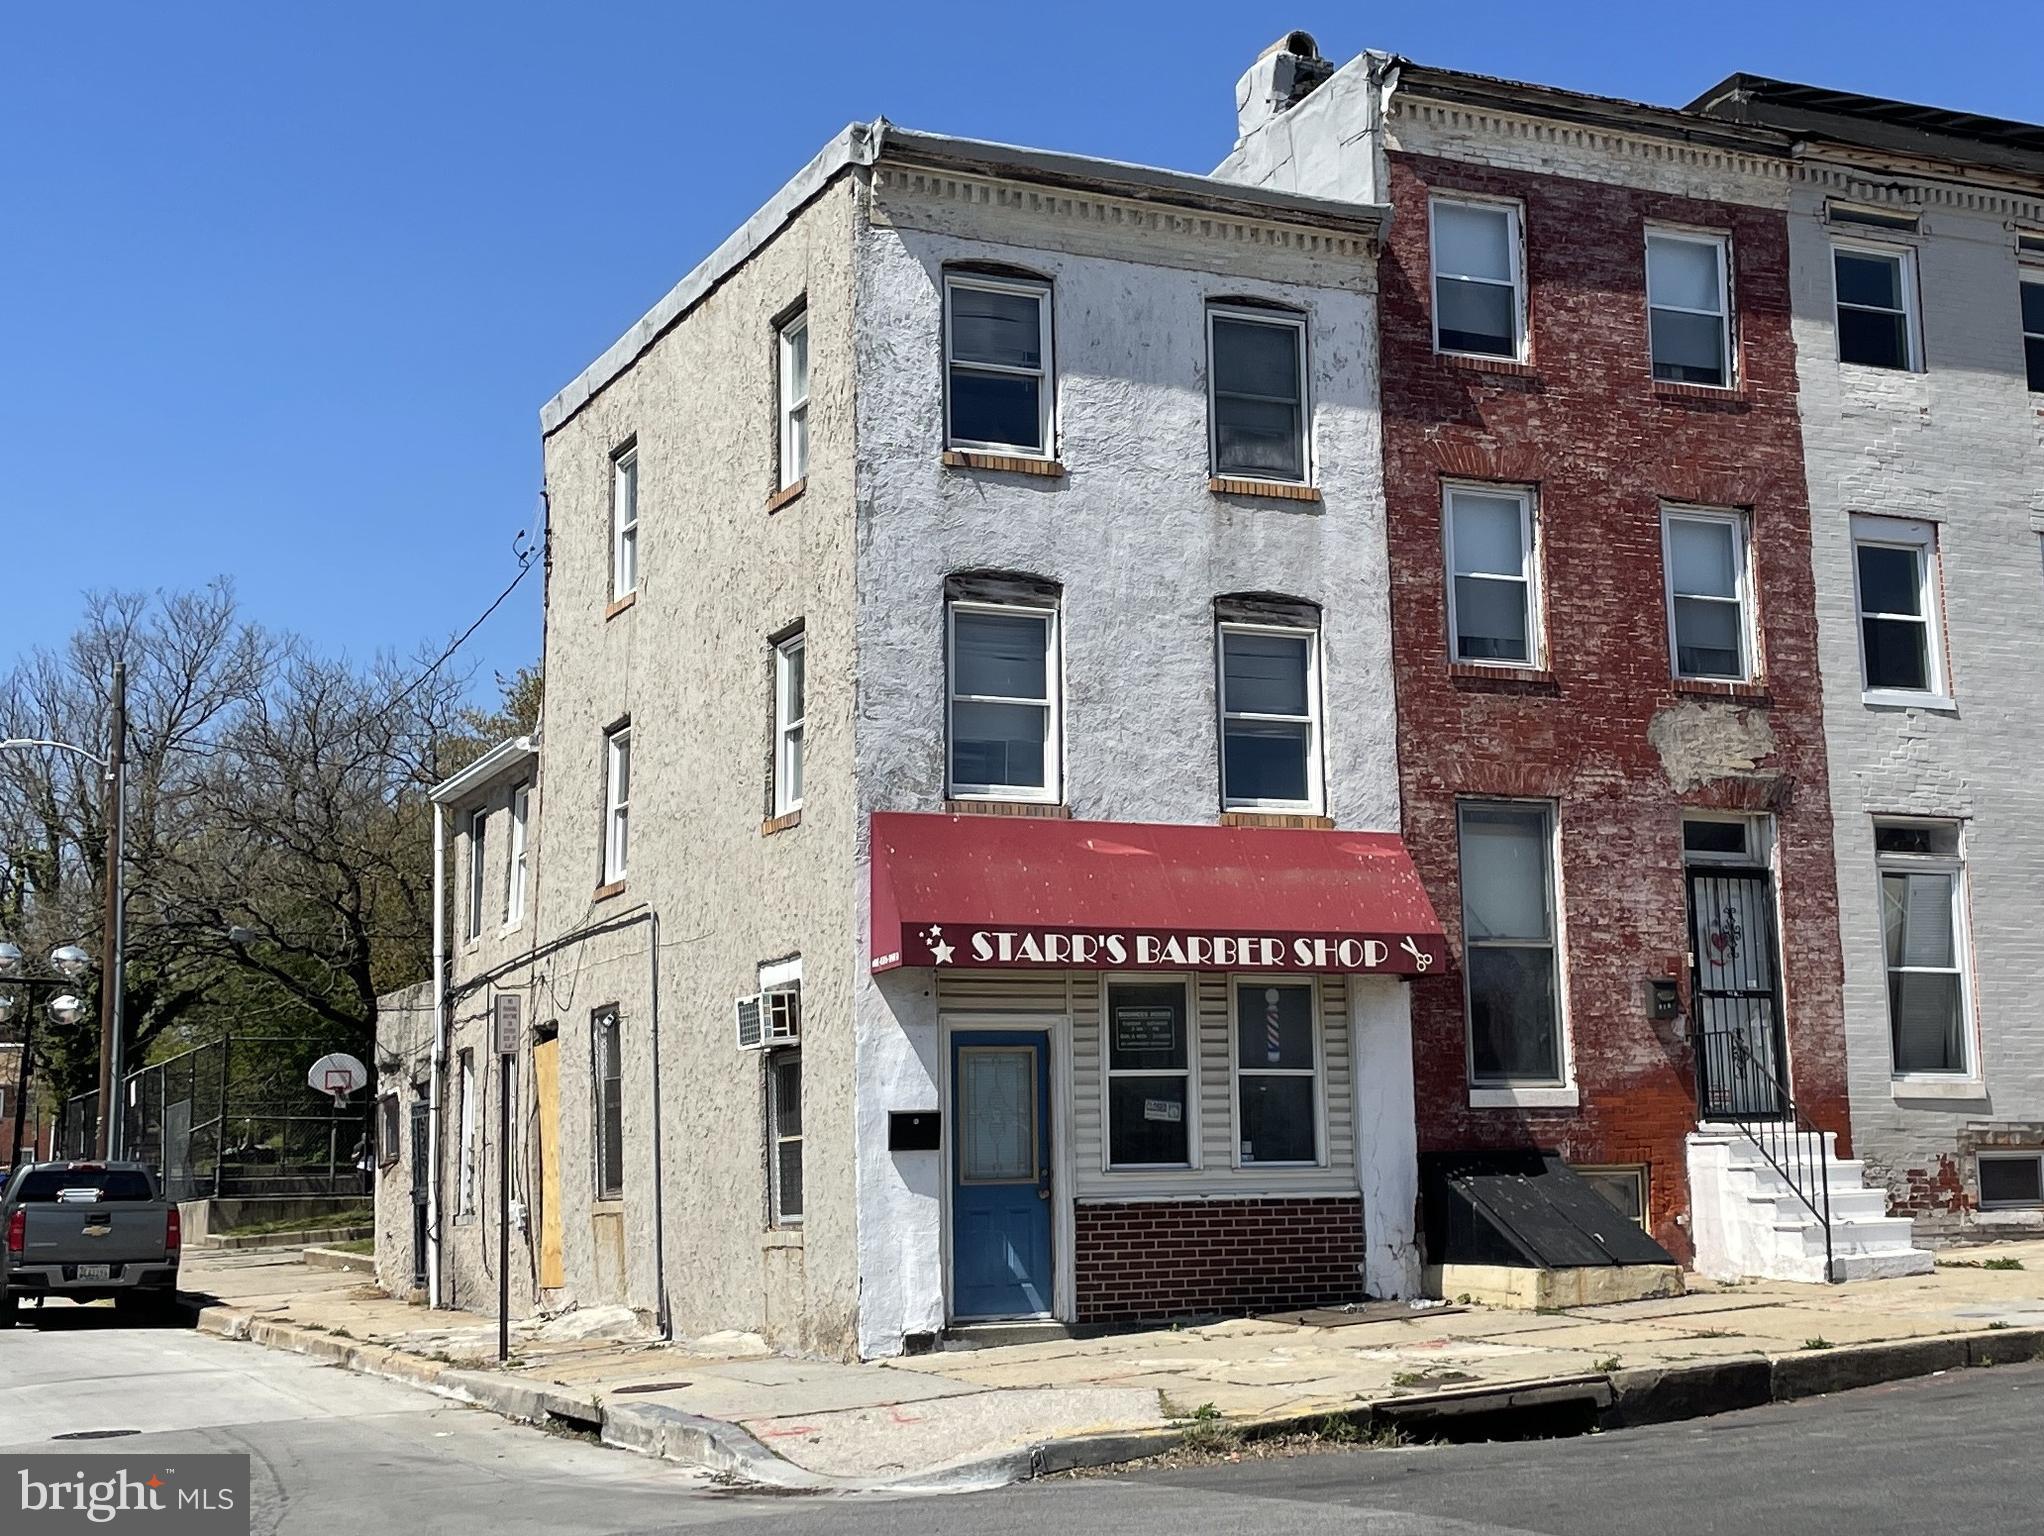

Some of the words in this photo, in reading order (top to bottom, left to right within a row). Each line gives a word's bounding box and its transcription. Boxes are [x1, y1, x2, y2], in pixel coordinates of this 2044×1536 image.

[971, 931, 1127, 965] STARR'S
[1136, 935, 1285, 966] BARBER
[1293, 938, 1389, 967] SHOP
